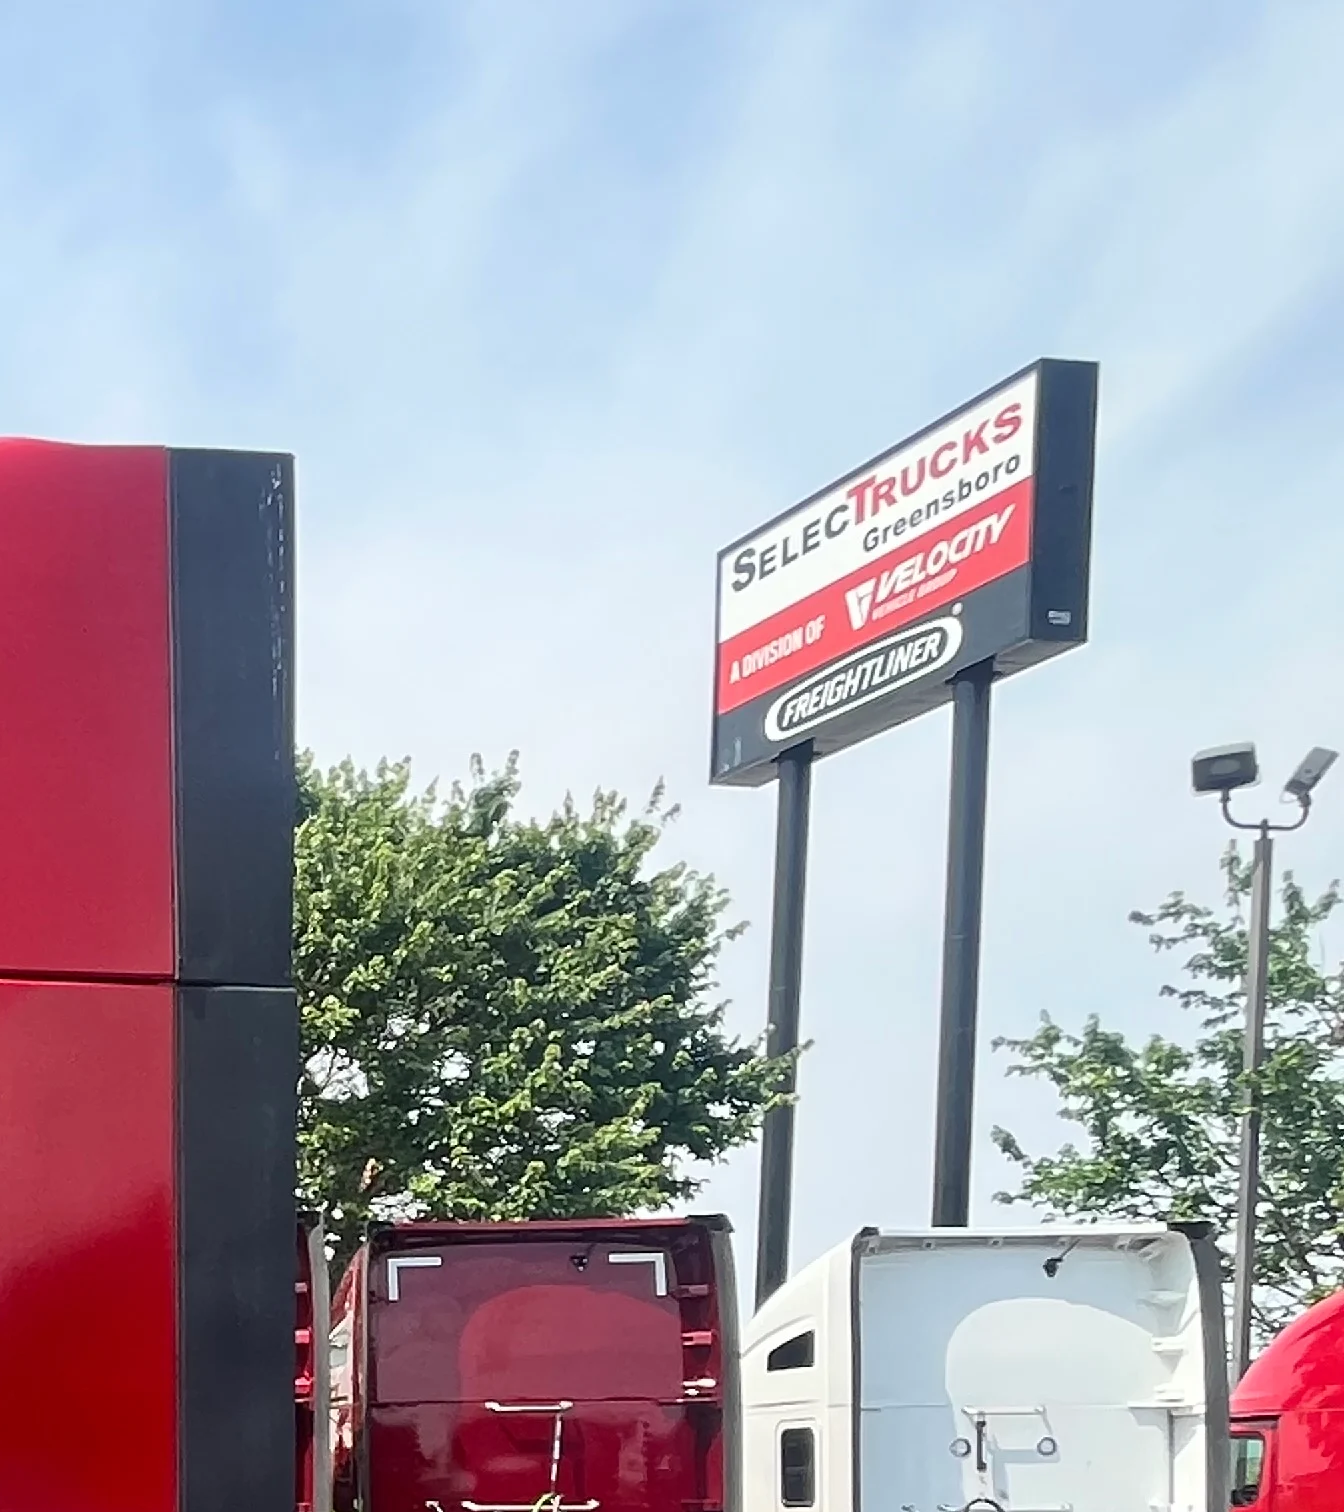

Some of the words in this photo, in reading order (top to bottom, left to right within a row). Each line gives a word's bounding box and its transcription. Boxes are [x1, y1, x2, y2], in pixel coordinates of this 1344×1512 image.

[863, 454, 1021, 552] Greensboro
[878, 503, 1016, 602] VELOCITY
[728, 659, 741, 684] A
[742, 625, 803, 678] DIVISION
[801, 614, 826, 644] OF
[781, 631, 942, 728] FREIGHTLINER
